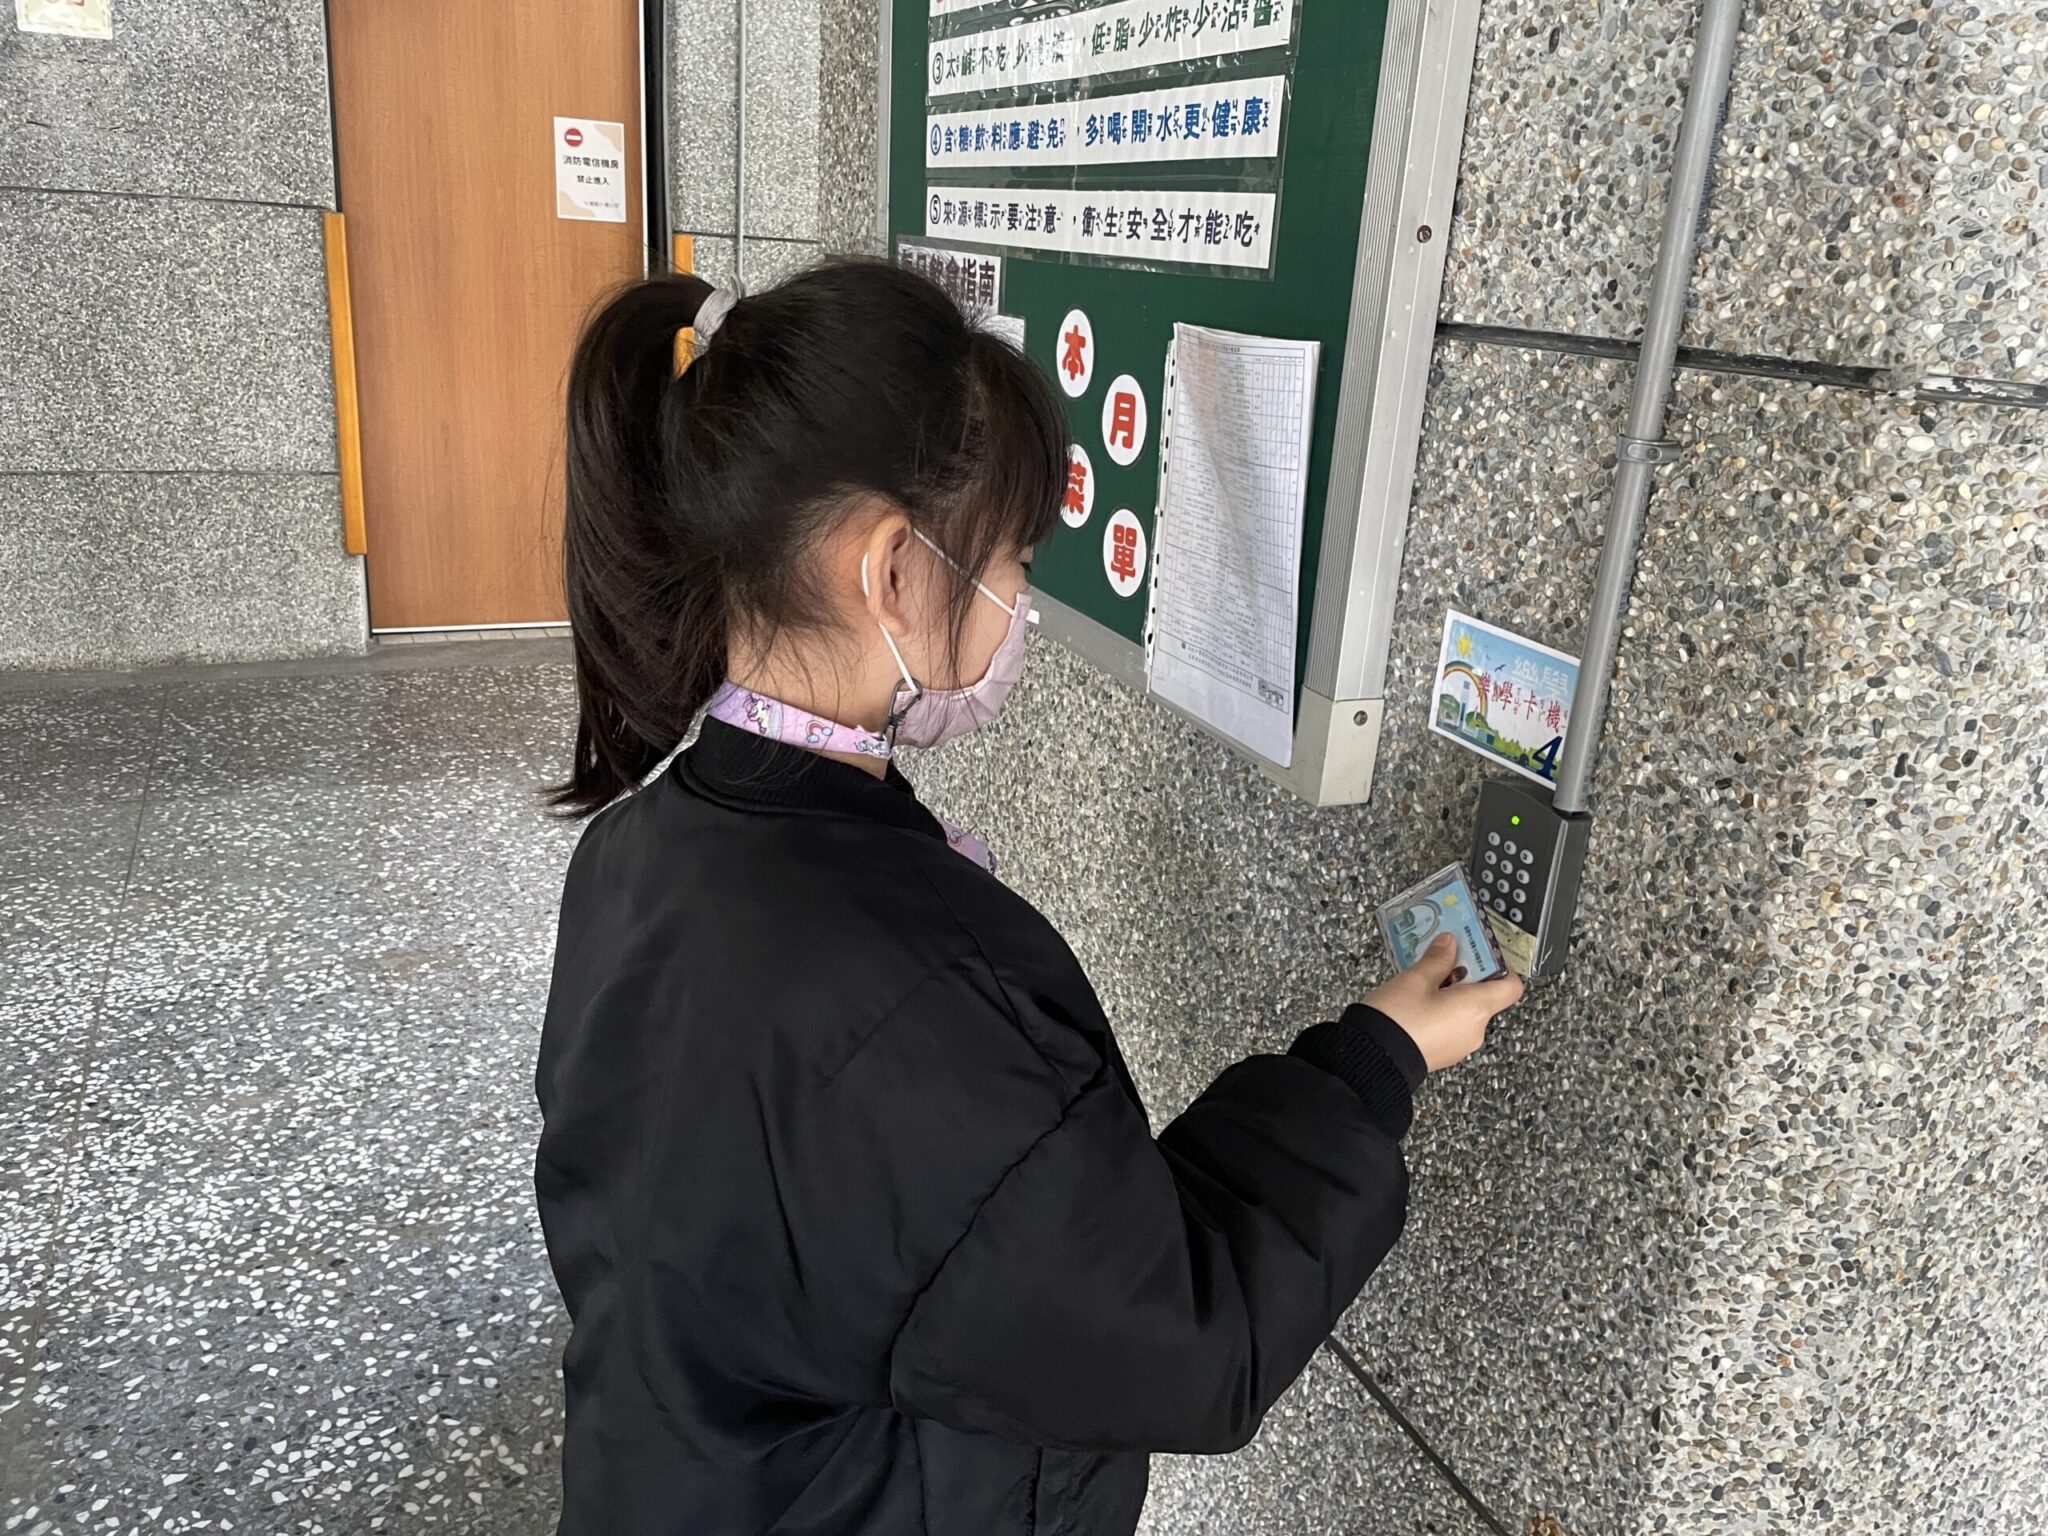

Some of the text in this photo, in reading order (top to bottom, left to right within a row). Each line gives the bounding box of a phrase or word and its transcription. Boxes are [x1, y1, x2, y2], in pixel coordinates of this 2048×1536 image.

[564, 156, 618, 169] 消防電信機房
[577, 175, 609, 185] 禁止進入
[1061, 324, 1086, 381] 本
[1110, 391, 1137, 449] 月
[1110, 524, 1138, 582] 單
[1533, 736, 1562, 780] 4
